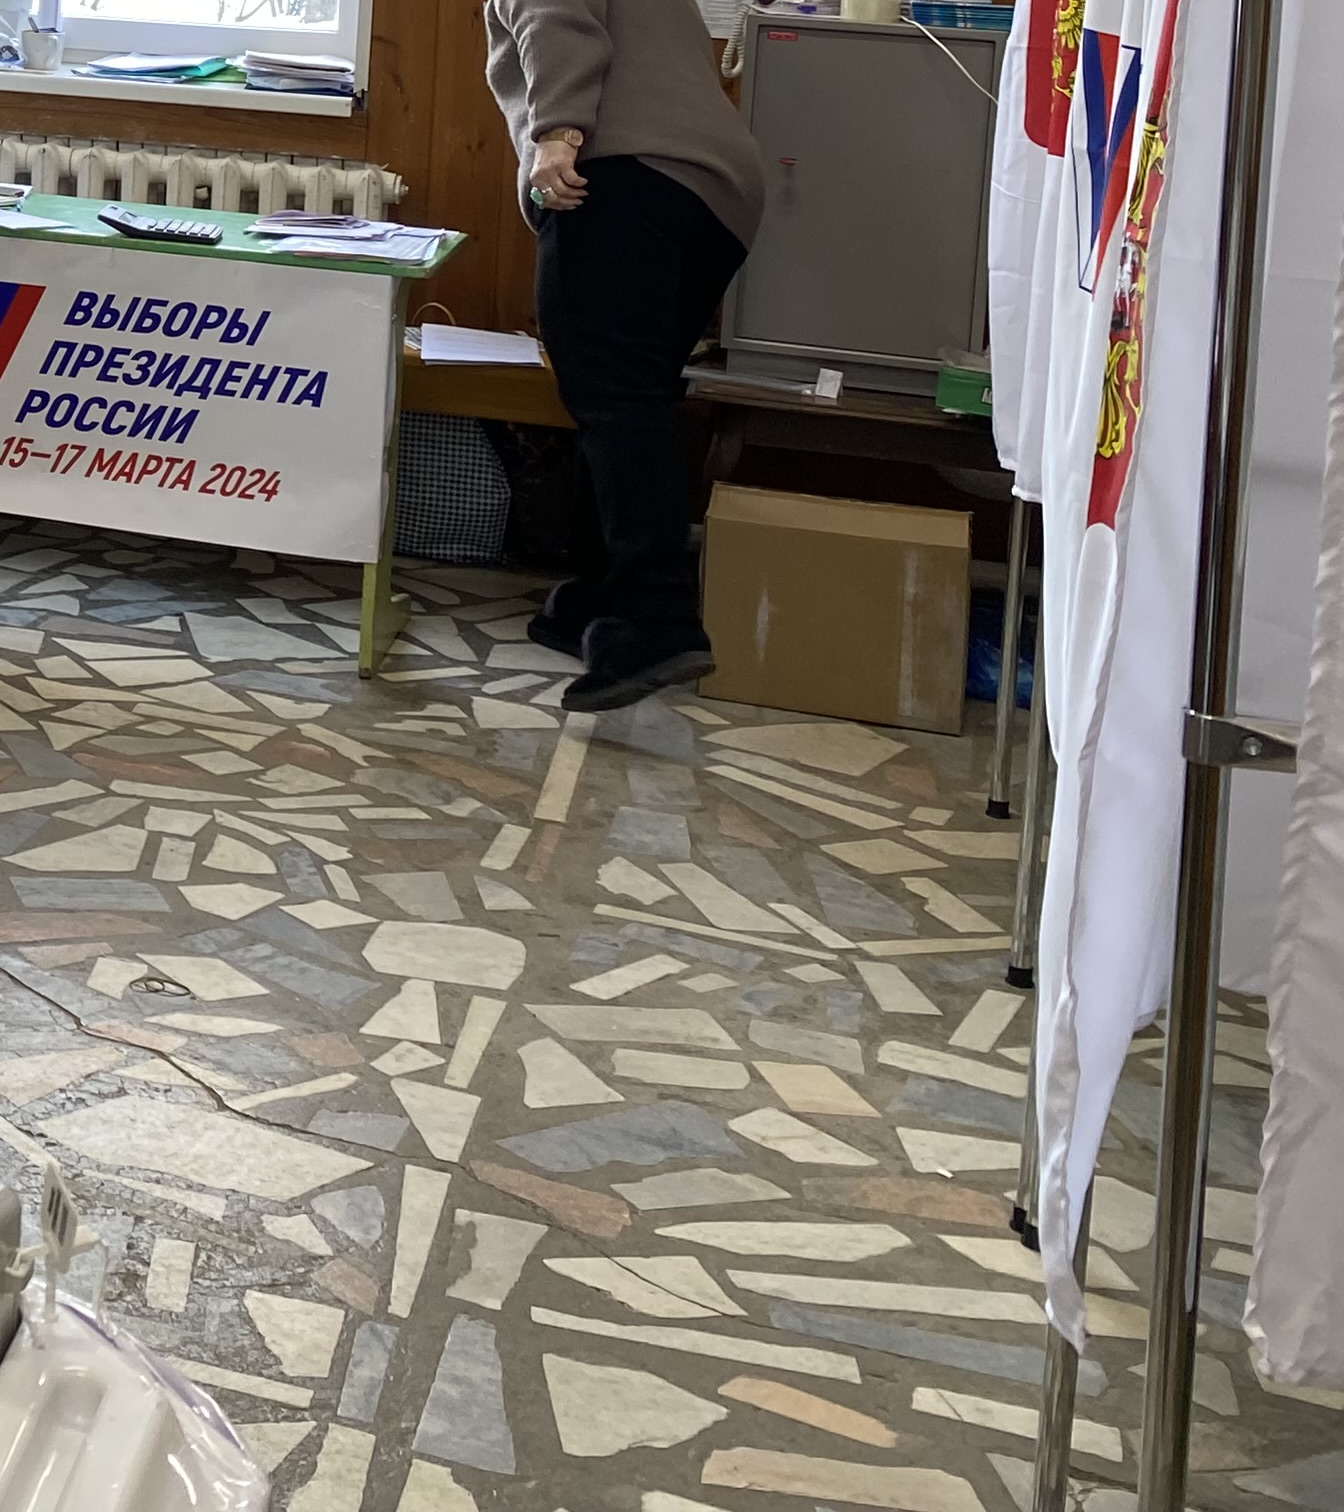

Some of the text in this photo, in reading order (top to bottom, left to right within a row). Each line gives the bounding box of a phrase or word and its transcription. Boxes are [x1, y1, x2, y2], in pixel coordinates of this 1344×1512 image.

[64, 289, 271, 346] ВЫБОРЫ
[39, 340, 330, 408] ПРЕЗИДЕНТА
[14, 389, 200, 444] РОССИИ
[88, 447, 196, 492] МАРТА
[198, 463, 283, 504] 2024
